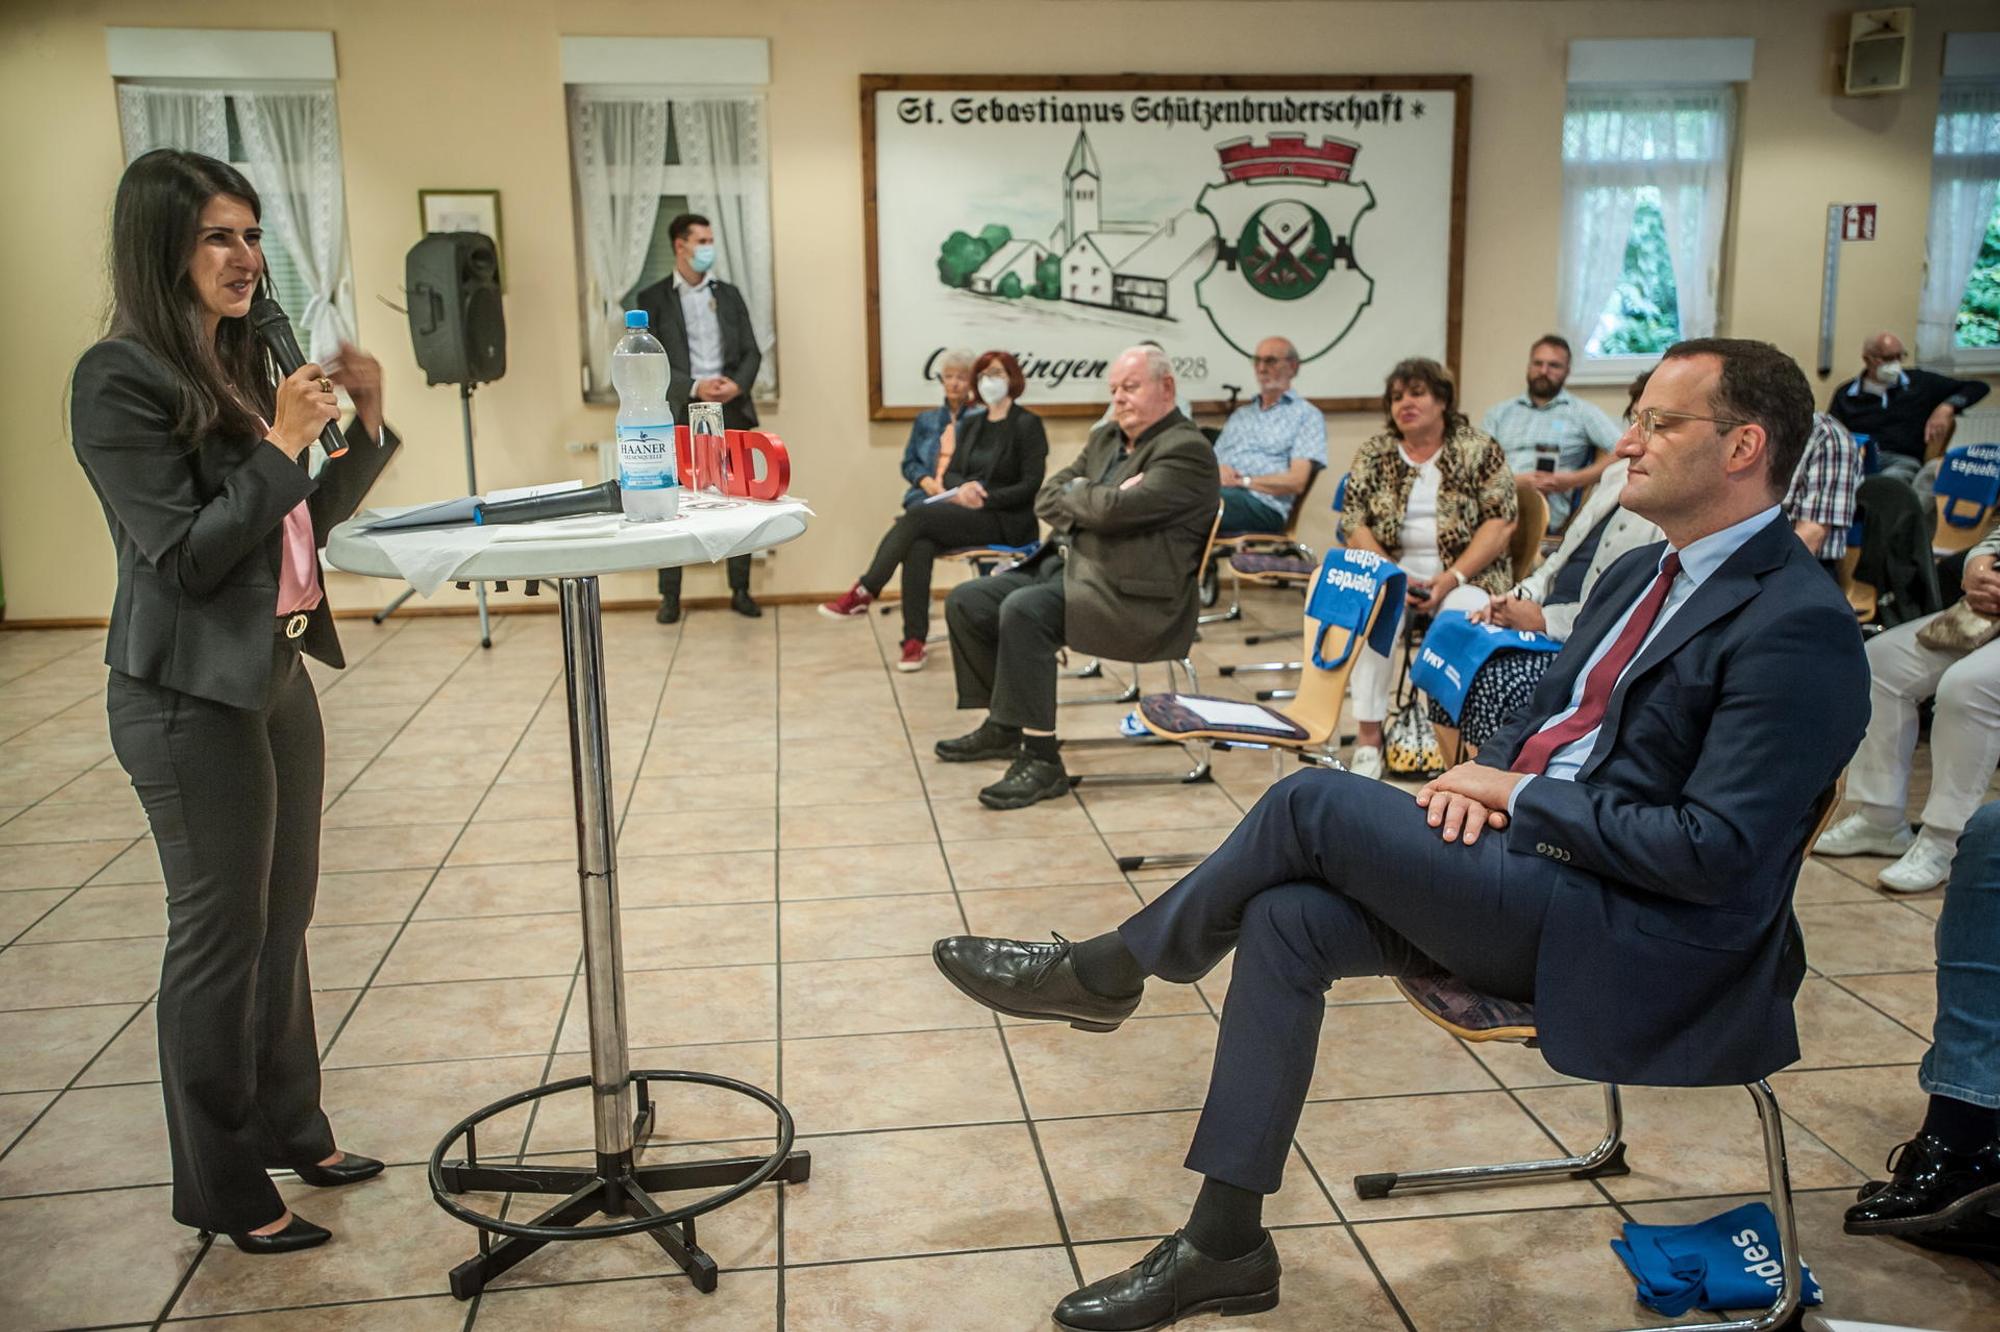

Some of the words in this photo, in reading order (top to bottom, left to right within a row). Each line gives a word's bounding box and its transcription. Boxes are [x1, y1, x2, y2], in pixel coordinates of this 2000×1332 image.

[897, 97, 943, 125] St.
[951, 96, 1124, 125] Sebastianus
[1131, 94, 1402, 130] Schützenbruderschaft
[1172, 356, 1209, 379] 928
[621, 443, 666, 454] HAANER
